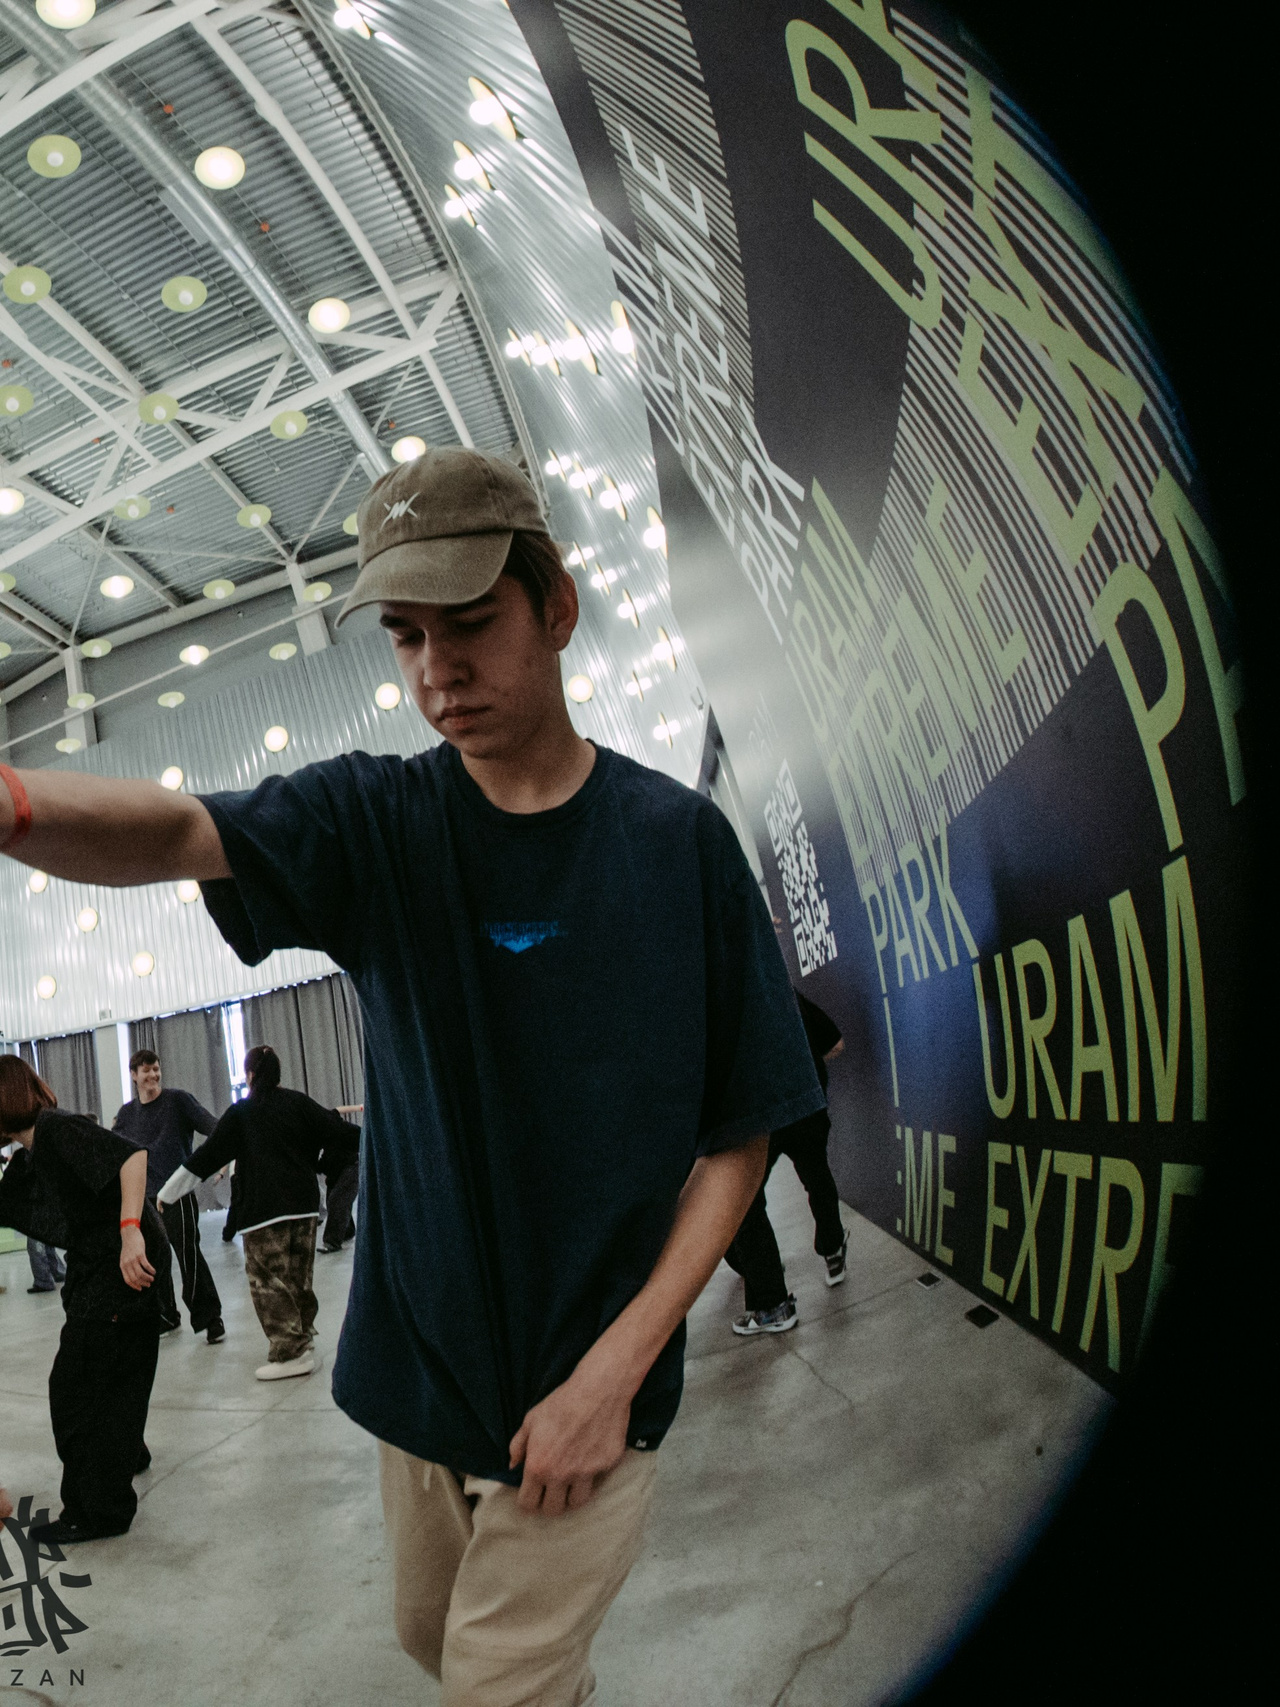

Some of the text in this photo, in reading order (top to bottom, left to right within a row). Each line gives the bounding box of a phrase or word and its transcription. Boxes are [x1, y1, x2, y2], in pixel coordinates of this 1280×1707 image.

[620, 125, 734, 548] EXTREME
[740, 395, 805, 645] PARK
[785, 476, 883, 746] URAM
[827, 476, 1030, 870] EXTREME
[860, 803, 980, 994] PARK
[972, 855, 1208, 1123] URAM
[896, 1124, 959, 1269] ME
